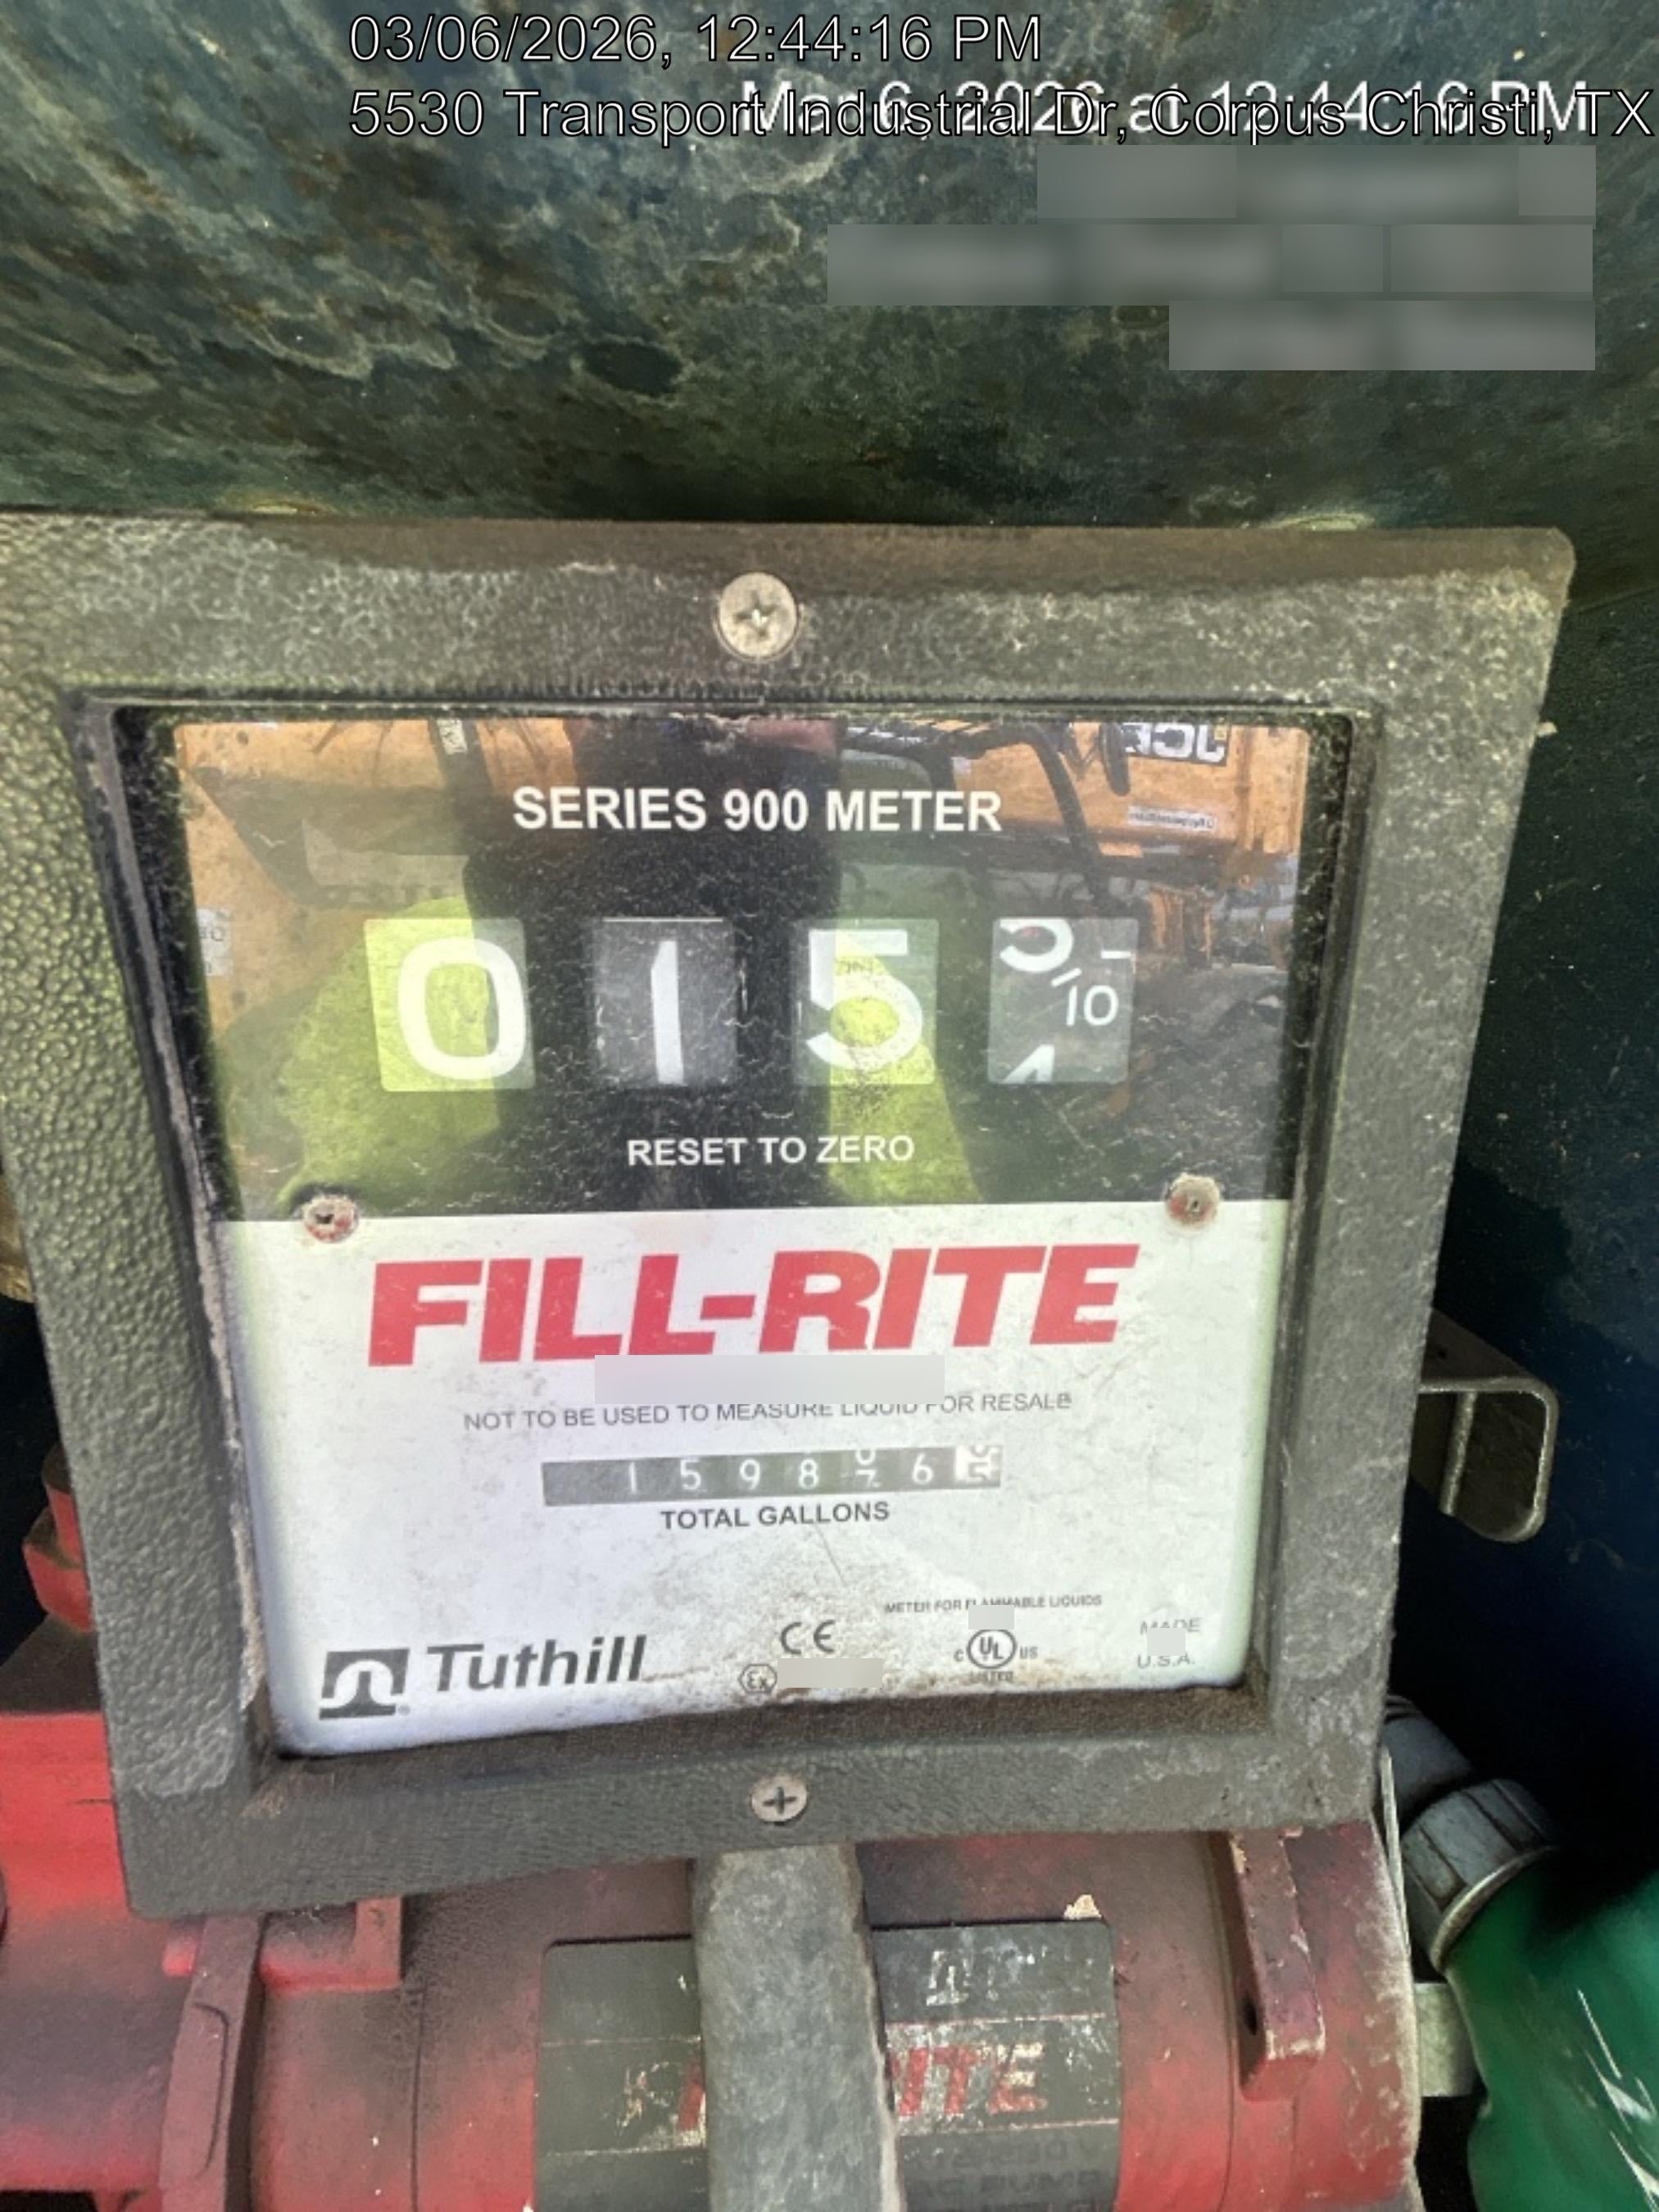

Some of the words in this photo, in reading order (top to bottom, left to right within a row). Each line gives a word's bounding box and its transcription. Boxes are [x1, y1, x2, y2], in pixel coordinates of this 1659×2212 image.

[512, 786, 707, 832] SERIES
[723, 788, 809, 832] 900
[826, 789, 1003, 833] METER
[628, 1138, 749, 1167] RESET
[758, 1137, 807, 1165] TO
[816, 1135, 916, 1163] ZERO
[368, 1244, 1140, 1367] FILL-RITE
[464, 1411, 516, 1431] NOT
[523, 1409, 556, 1429] TO
[564, 1407, 596, 1427] BE
[603, 1405, 670, 1426] USED
[677, 1403, 709, 1422] TO
[716, 1403, 834, 1421] MEASURE
[981, 1391, 1072, 1412] RESALE
[661, 1507, 750, 1531] TOTAL
[758, 1500, 891, 1527] GALLONS
[426, 1634, 647, 1693] Tuthill
